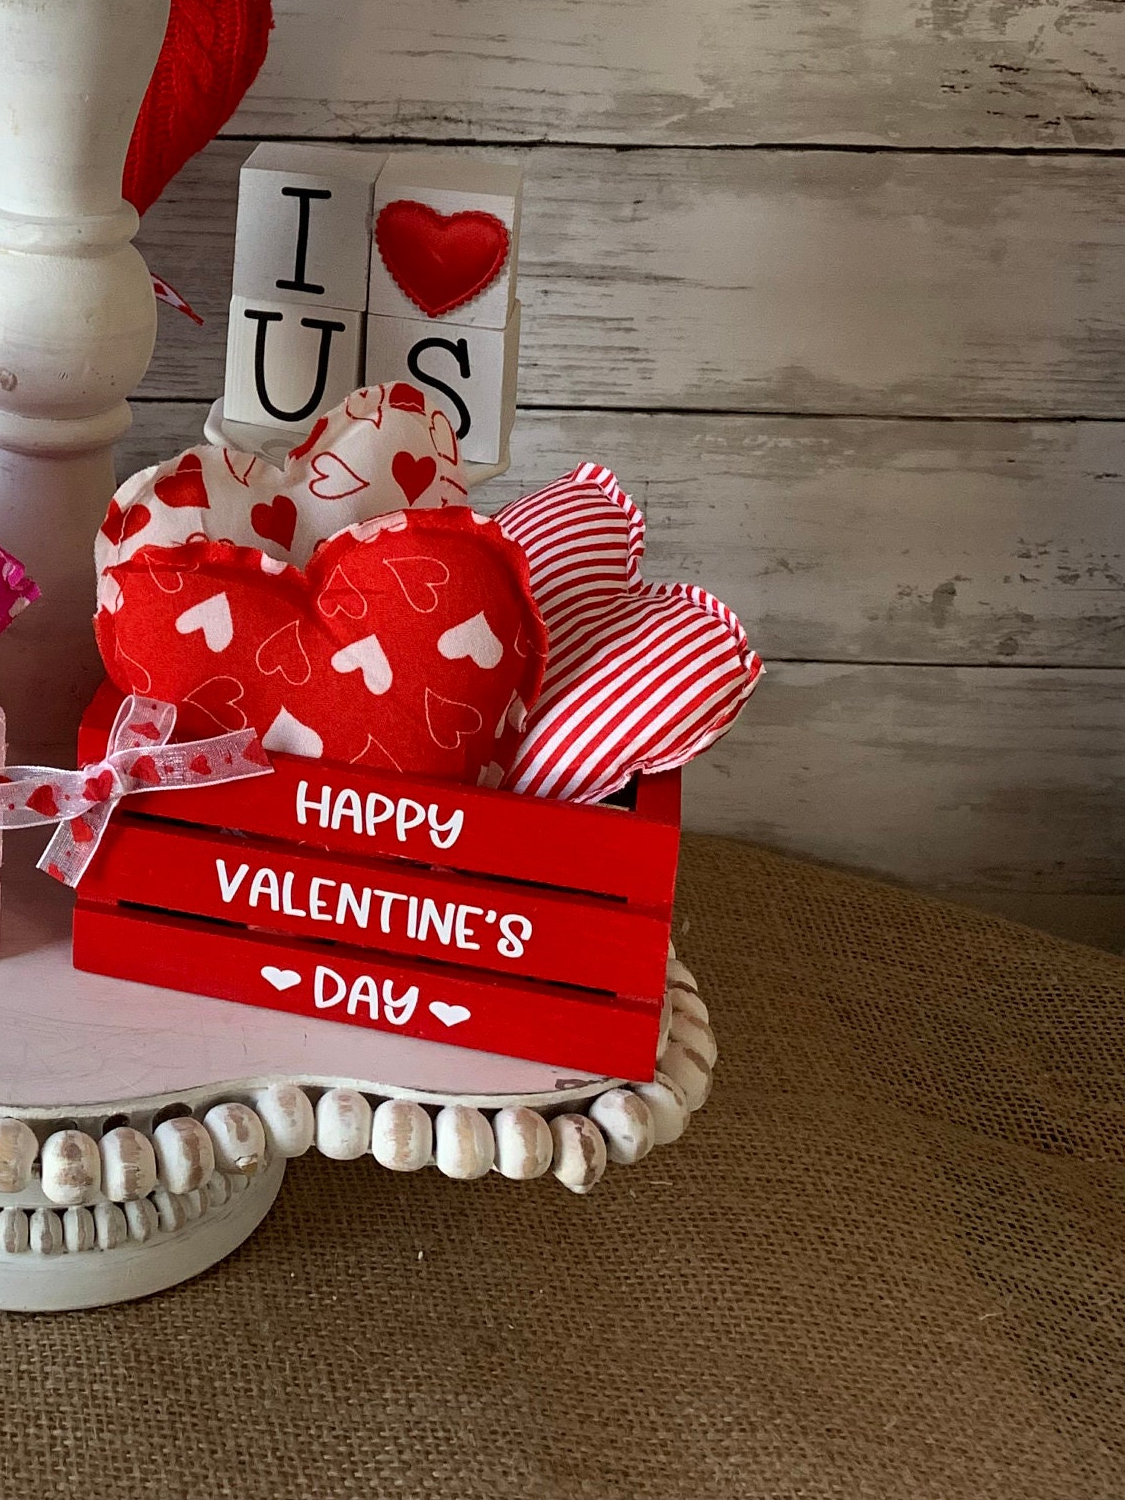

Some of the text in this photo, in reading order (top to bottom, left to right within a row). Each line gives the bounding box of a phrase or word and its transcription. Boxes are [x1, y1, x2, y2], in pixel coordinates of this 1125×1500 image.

[275, 186, 332, 295] I
[295, 780, 465, 849] HAPPY
[215, 858, 533, 958] VALENTINE'S
[313, 965, 419, 1026] DAY
